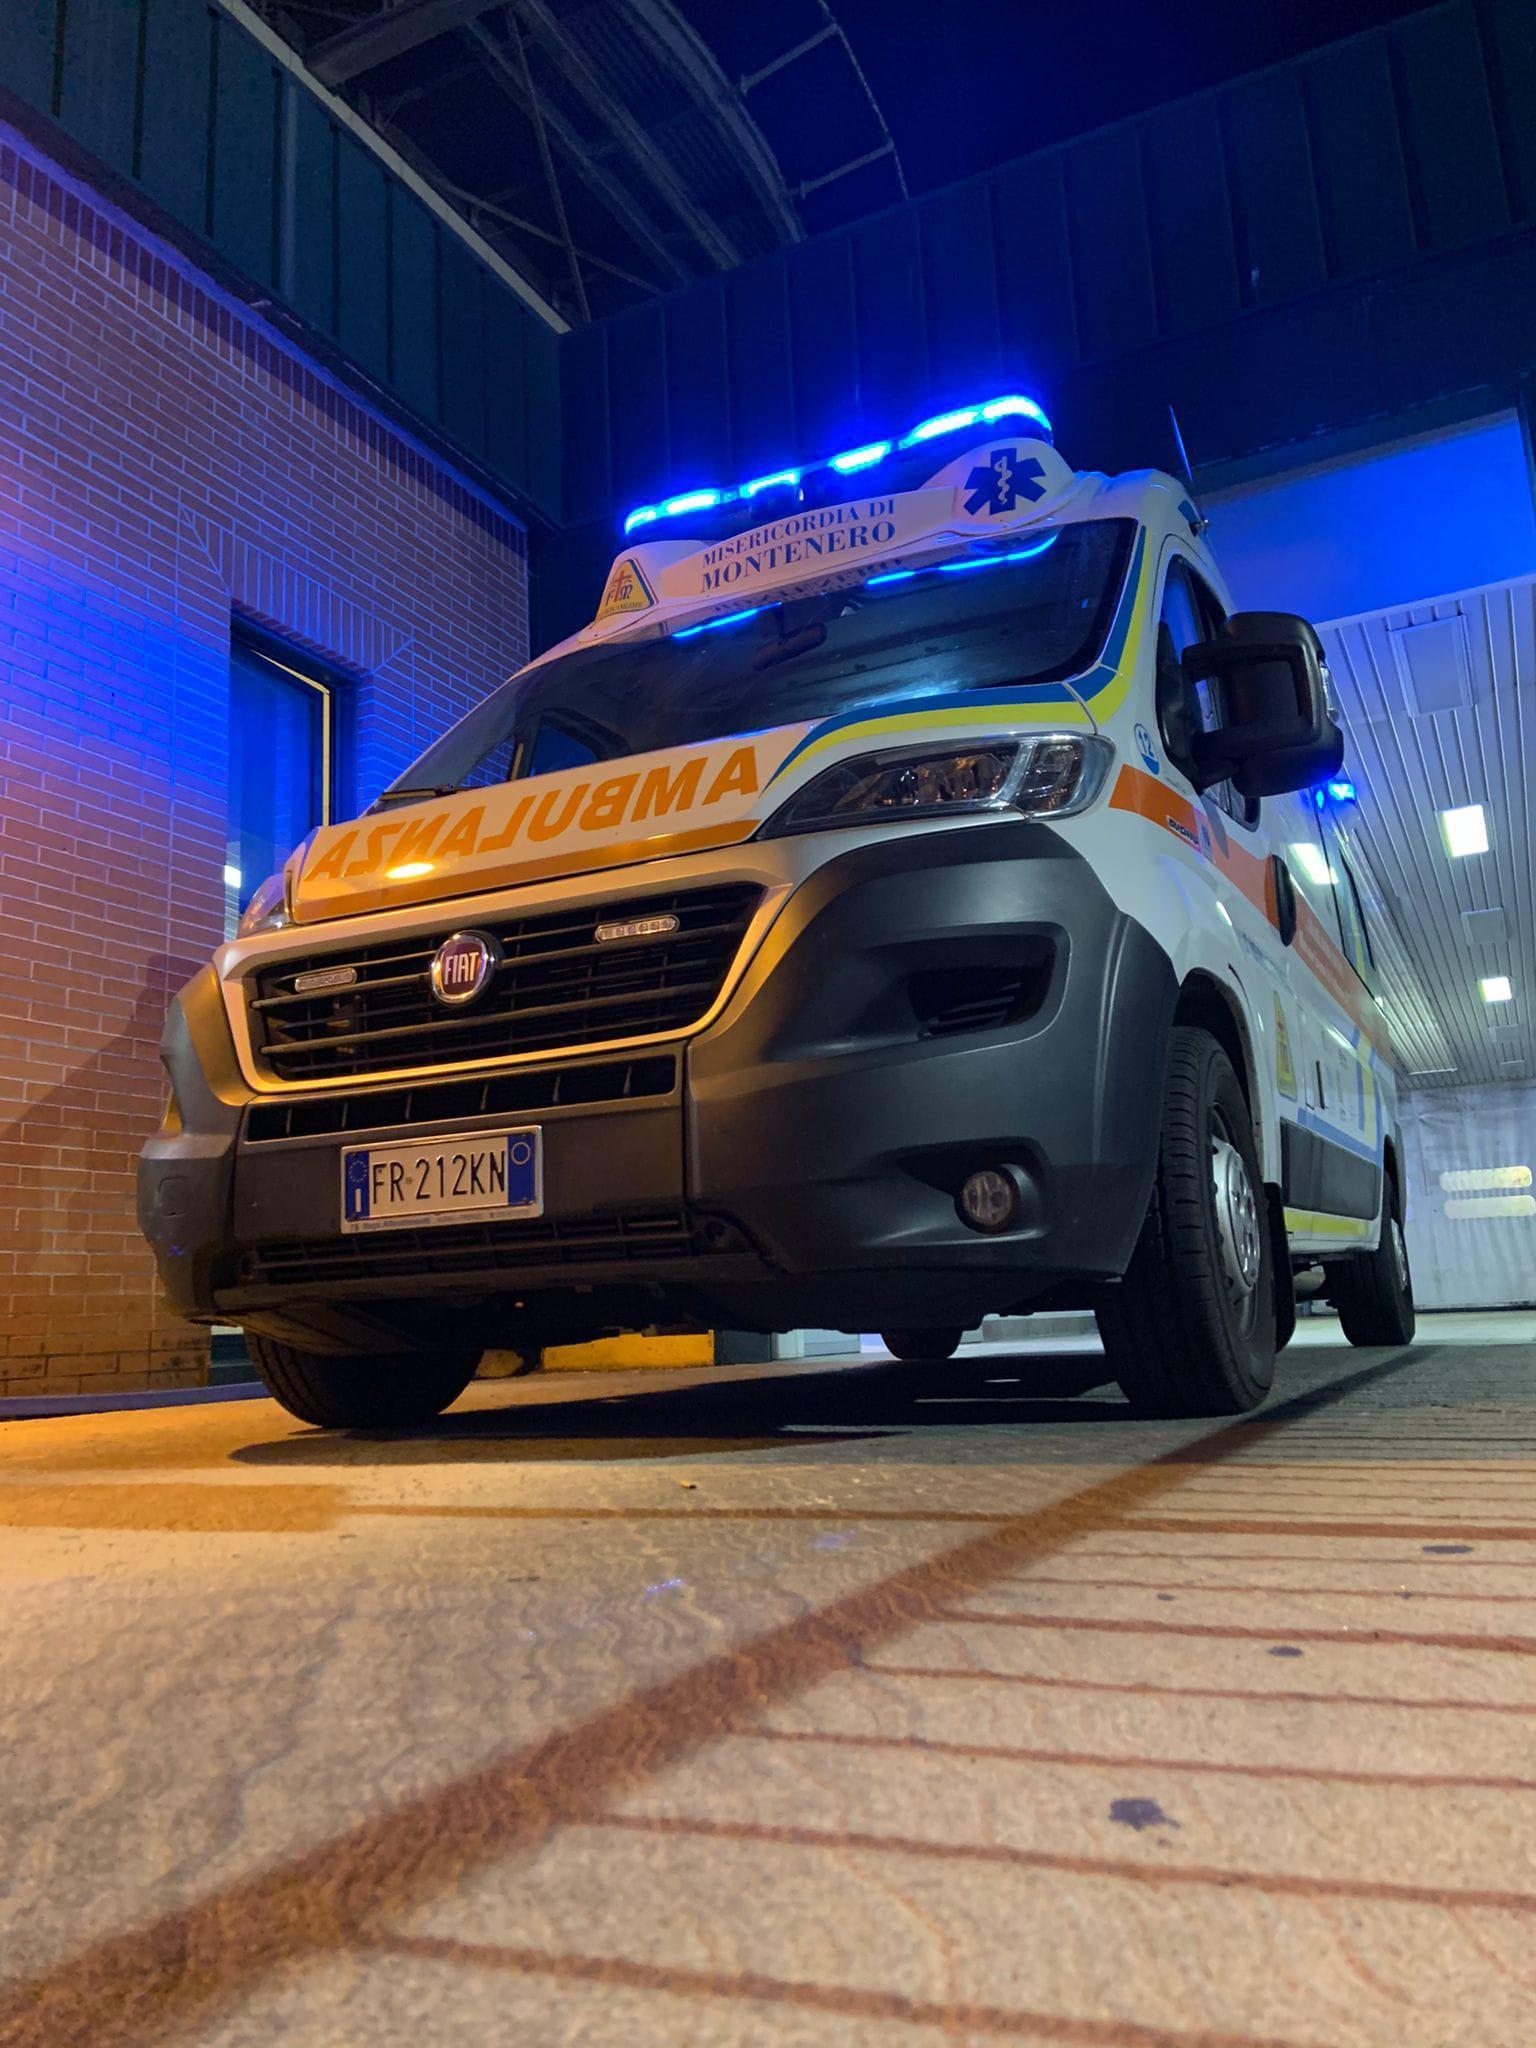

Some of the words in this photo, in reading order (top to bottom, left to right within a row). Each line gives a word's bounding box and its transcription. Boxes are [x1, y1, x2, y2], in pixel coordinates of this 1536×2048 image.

[701, 521, 896, 594] MONTENERO
[702, 506, 860, 569] MISERICORDIA
[869, 499, 895, 518] DI
[444, 952, 479, 985] FIAT
